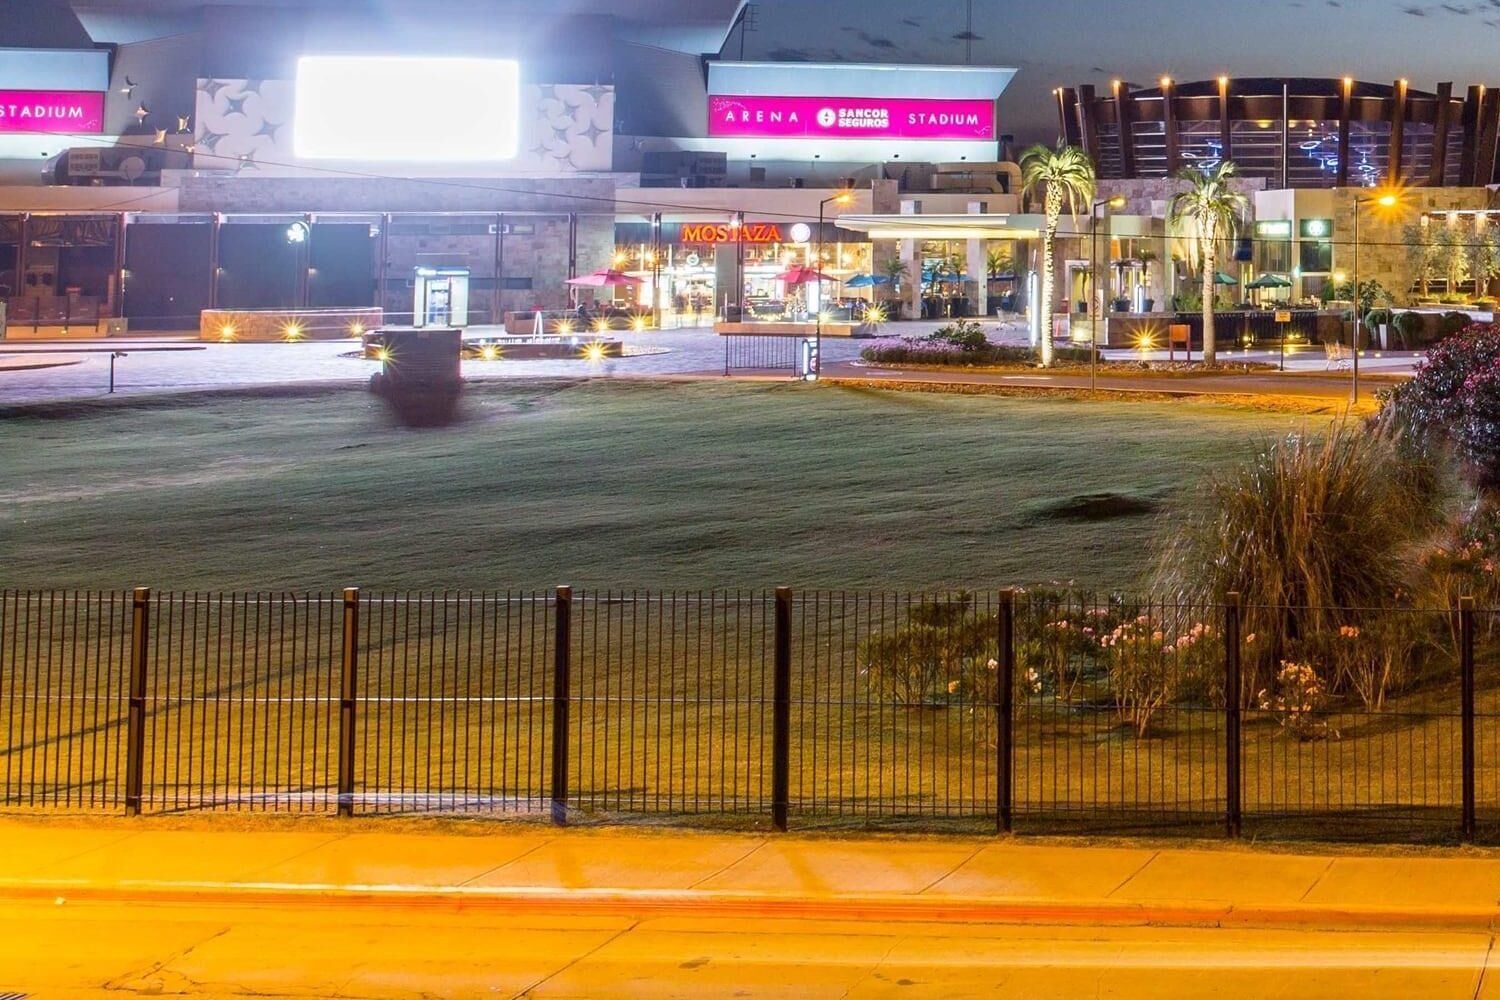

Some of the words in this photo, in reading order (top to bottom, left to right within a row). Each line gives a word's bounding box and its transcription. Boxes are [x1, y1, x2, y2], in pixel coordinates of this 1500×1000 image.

[725, 110, 799, 123] ARENA
[838, 108, 889, 119] SANCOR
[908, 113, 979, 125] STADIUM
[838, 117, 889, 128] SEGUROS
[682, 224, 782, 242] MOSTAZA
